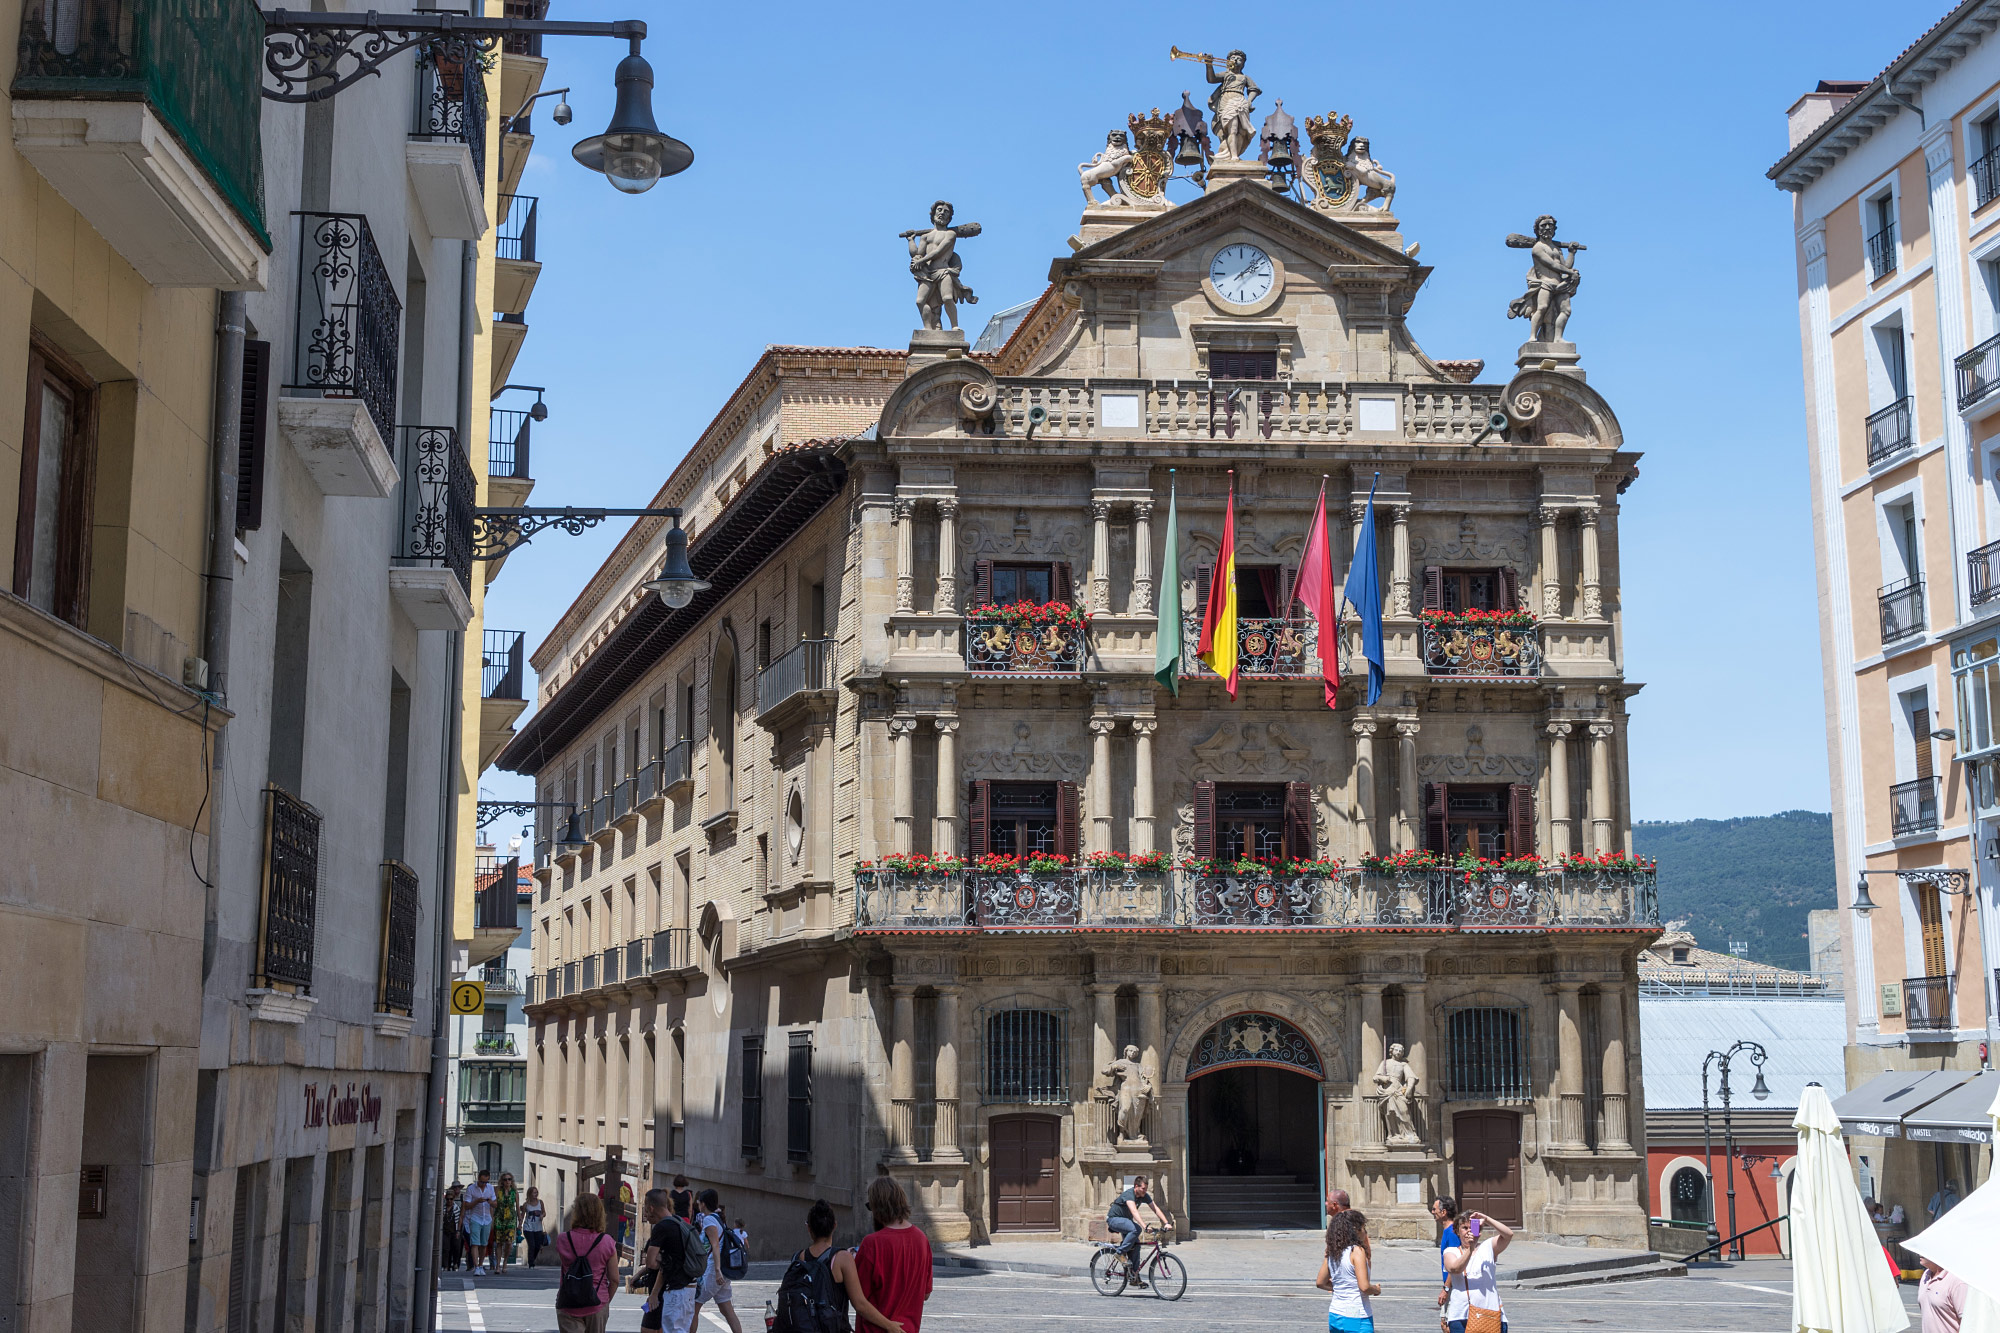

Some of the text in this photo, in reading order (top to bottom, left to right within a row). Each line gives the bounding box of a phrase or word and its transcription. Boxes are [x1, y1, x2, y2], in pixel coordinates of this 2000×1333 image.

[304, 1082, 381, 1134] The Cookie Shop
[1913, 1128, 1932, 1137] AMSTEL
